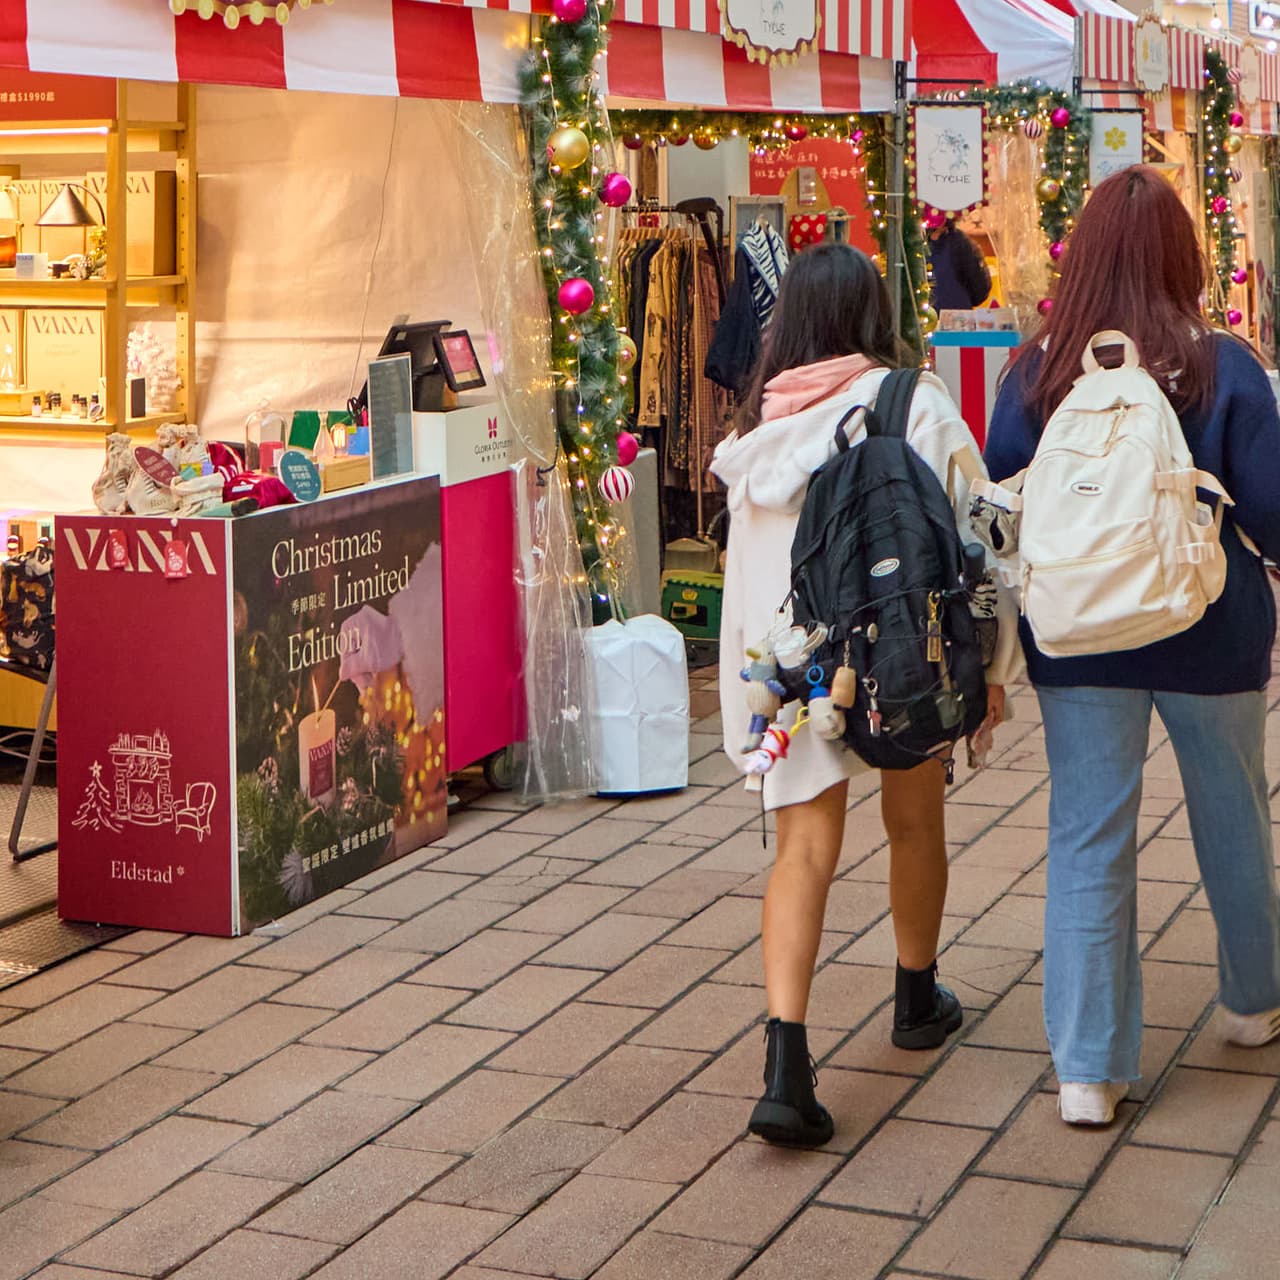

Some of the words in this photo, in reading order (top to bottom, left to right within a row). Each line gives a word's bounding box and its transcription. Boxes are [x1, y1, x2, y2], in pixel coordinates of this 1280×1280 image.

[763, 20, 785, 36] TYCHE
[933, 174, 971, 184] TYCHE
[32, 315, 95, 335] VANA
[63, 528, 217, 575] VANA
[271, 529, 382, 579] Christmas
[333, 555, 410, 610] Limited
[290, 592, 326, 616] 季節限定
[288, 621, 362, 672] Edition
[111, 860, 173, 884] Eldstad
